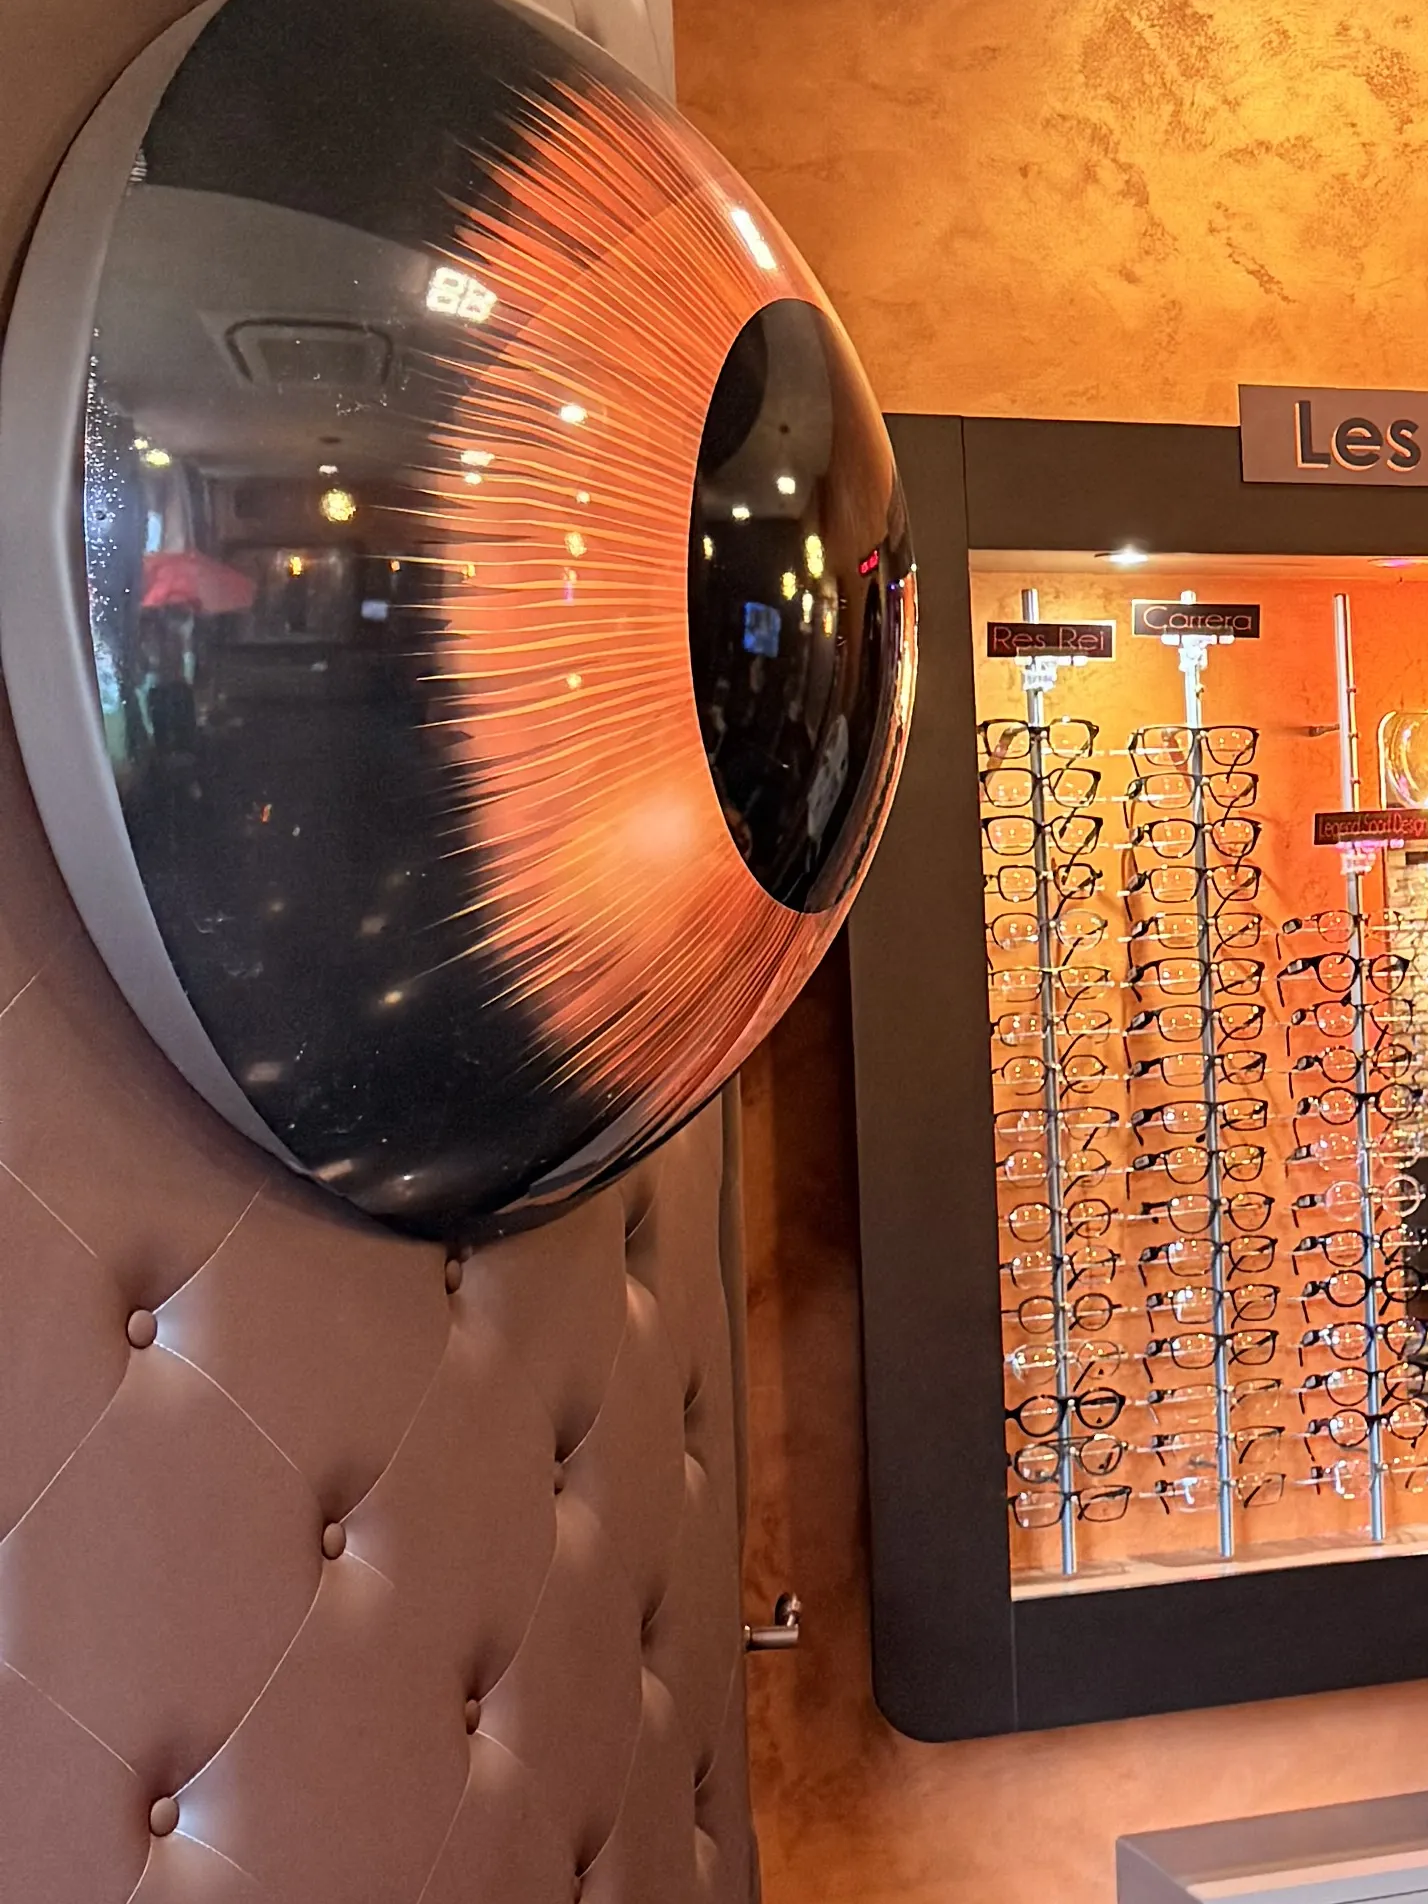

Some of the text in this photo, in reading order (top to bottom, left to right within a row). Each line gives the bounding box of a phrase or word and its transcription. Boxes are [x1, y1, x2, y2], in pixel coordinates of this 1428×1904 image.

[1295, 400, 1422, 472] Les
[1143, 606, 1252, 630] Carrera
[993, 626, 1105, 651] Res Rei
